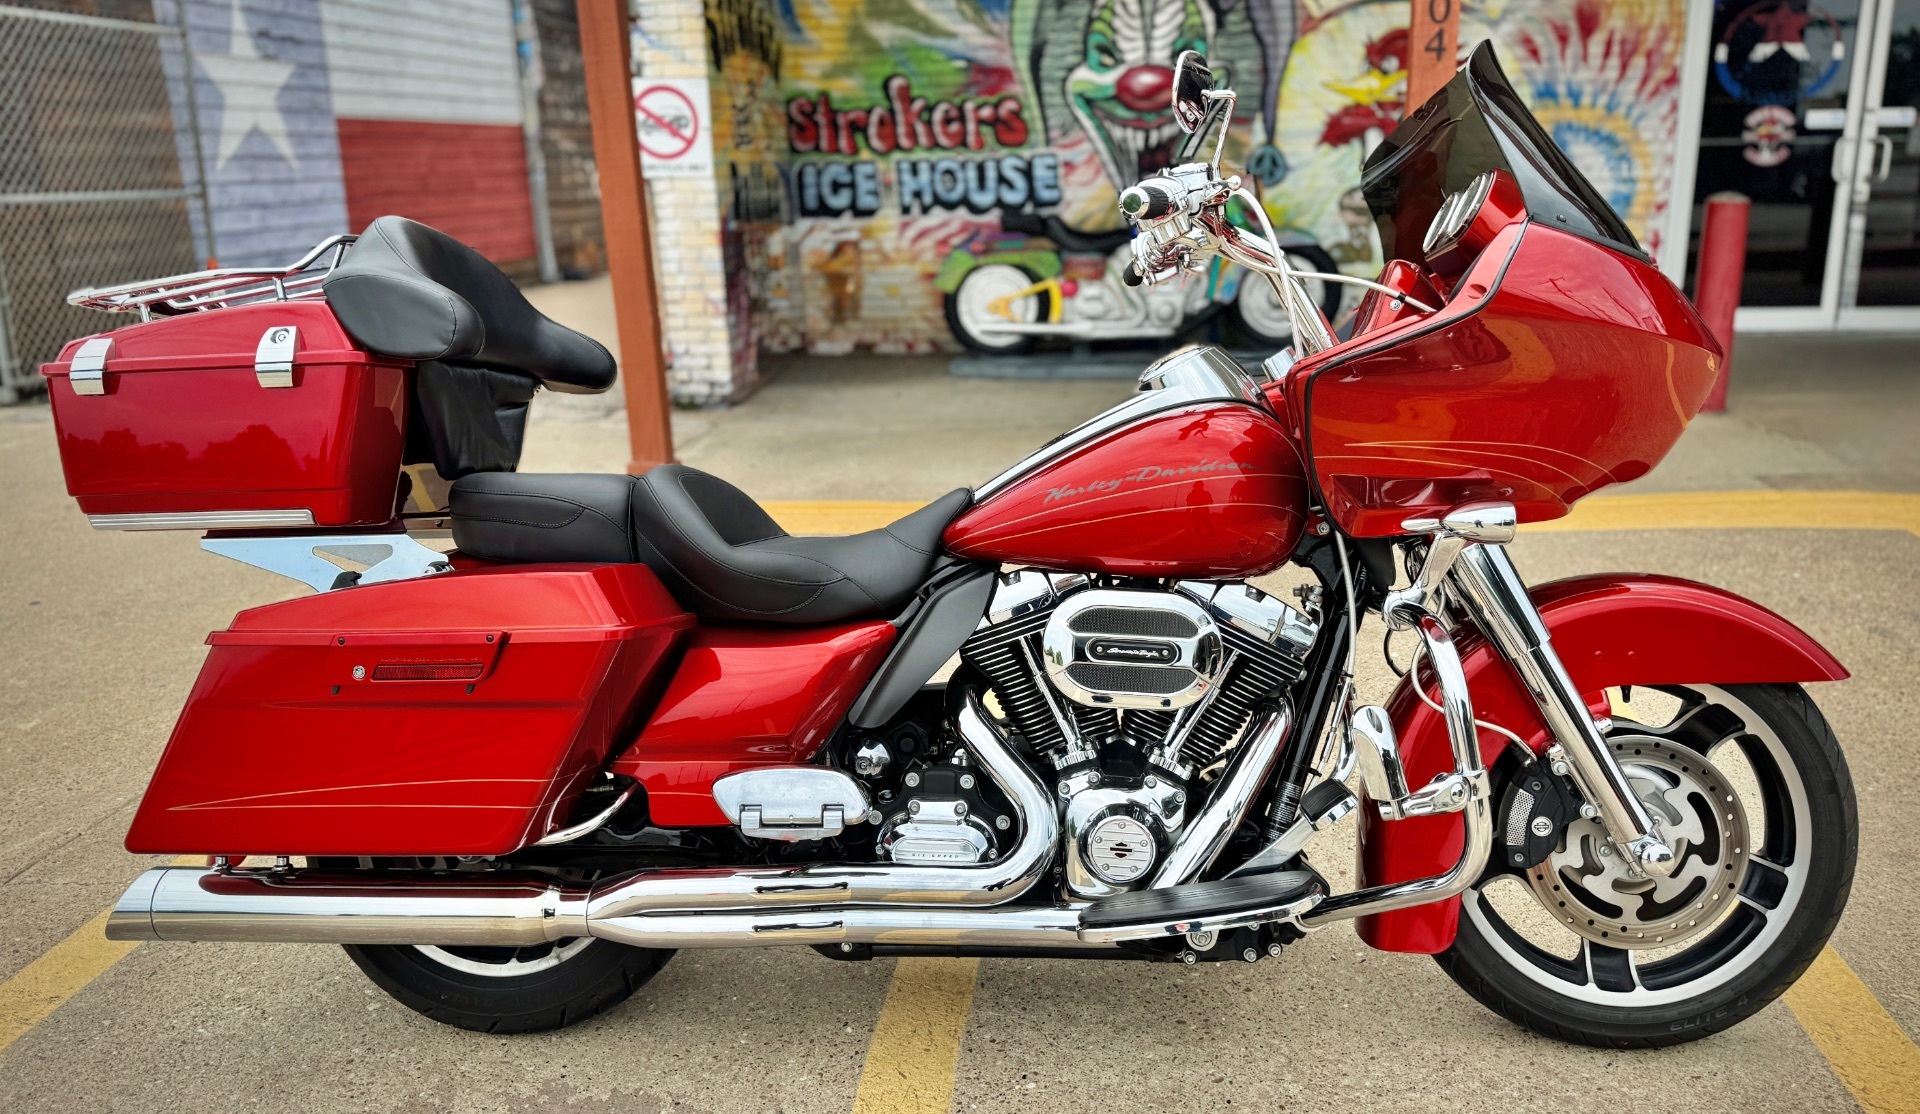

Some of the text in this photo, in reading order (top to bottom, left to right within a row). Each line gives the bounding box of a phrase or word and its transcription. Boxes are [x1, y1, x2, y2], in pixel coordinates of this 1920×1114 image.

[789, 76, 1028, 154] Strokers
[802, 155, 1062, 214] ICE HOUSE
[1669, 1006, 1727, 1031] ELITE
[1737, 994, 1749, 1007] 4
